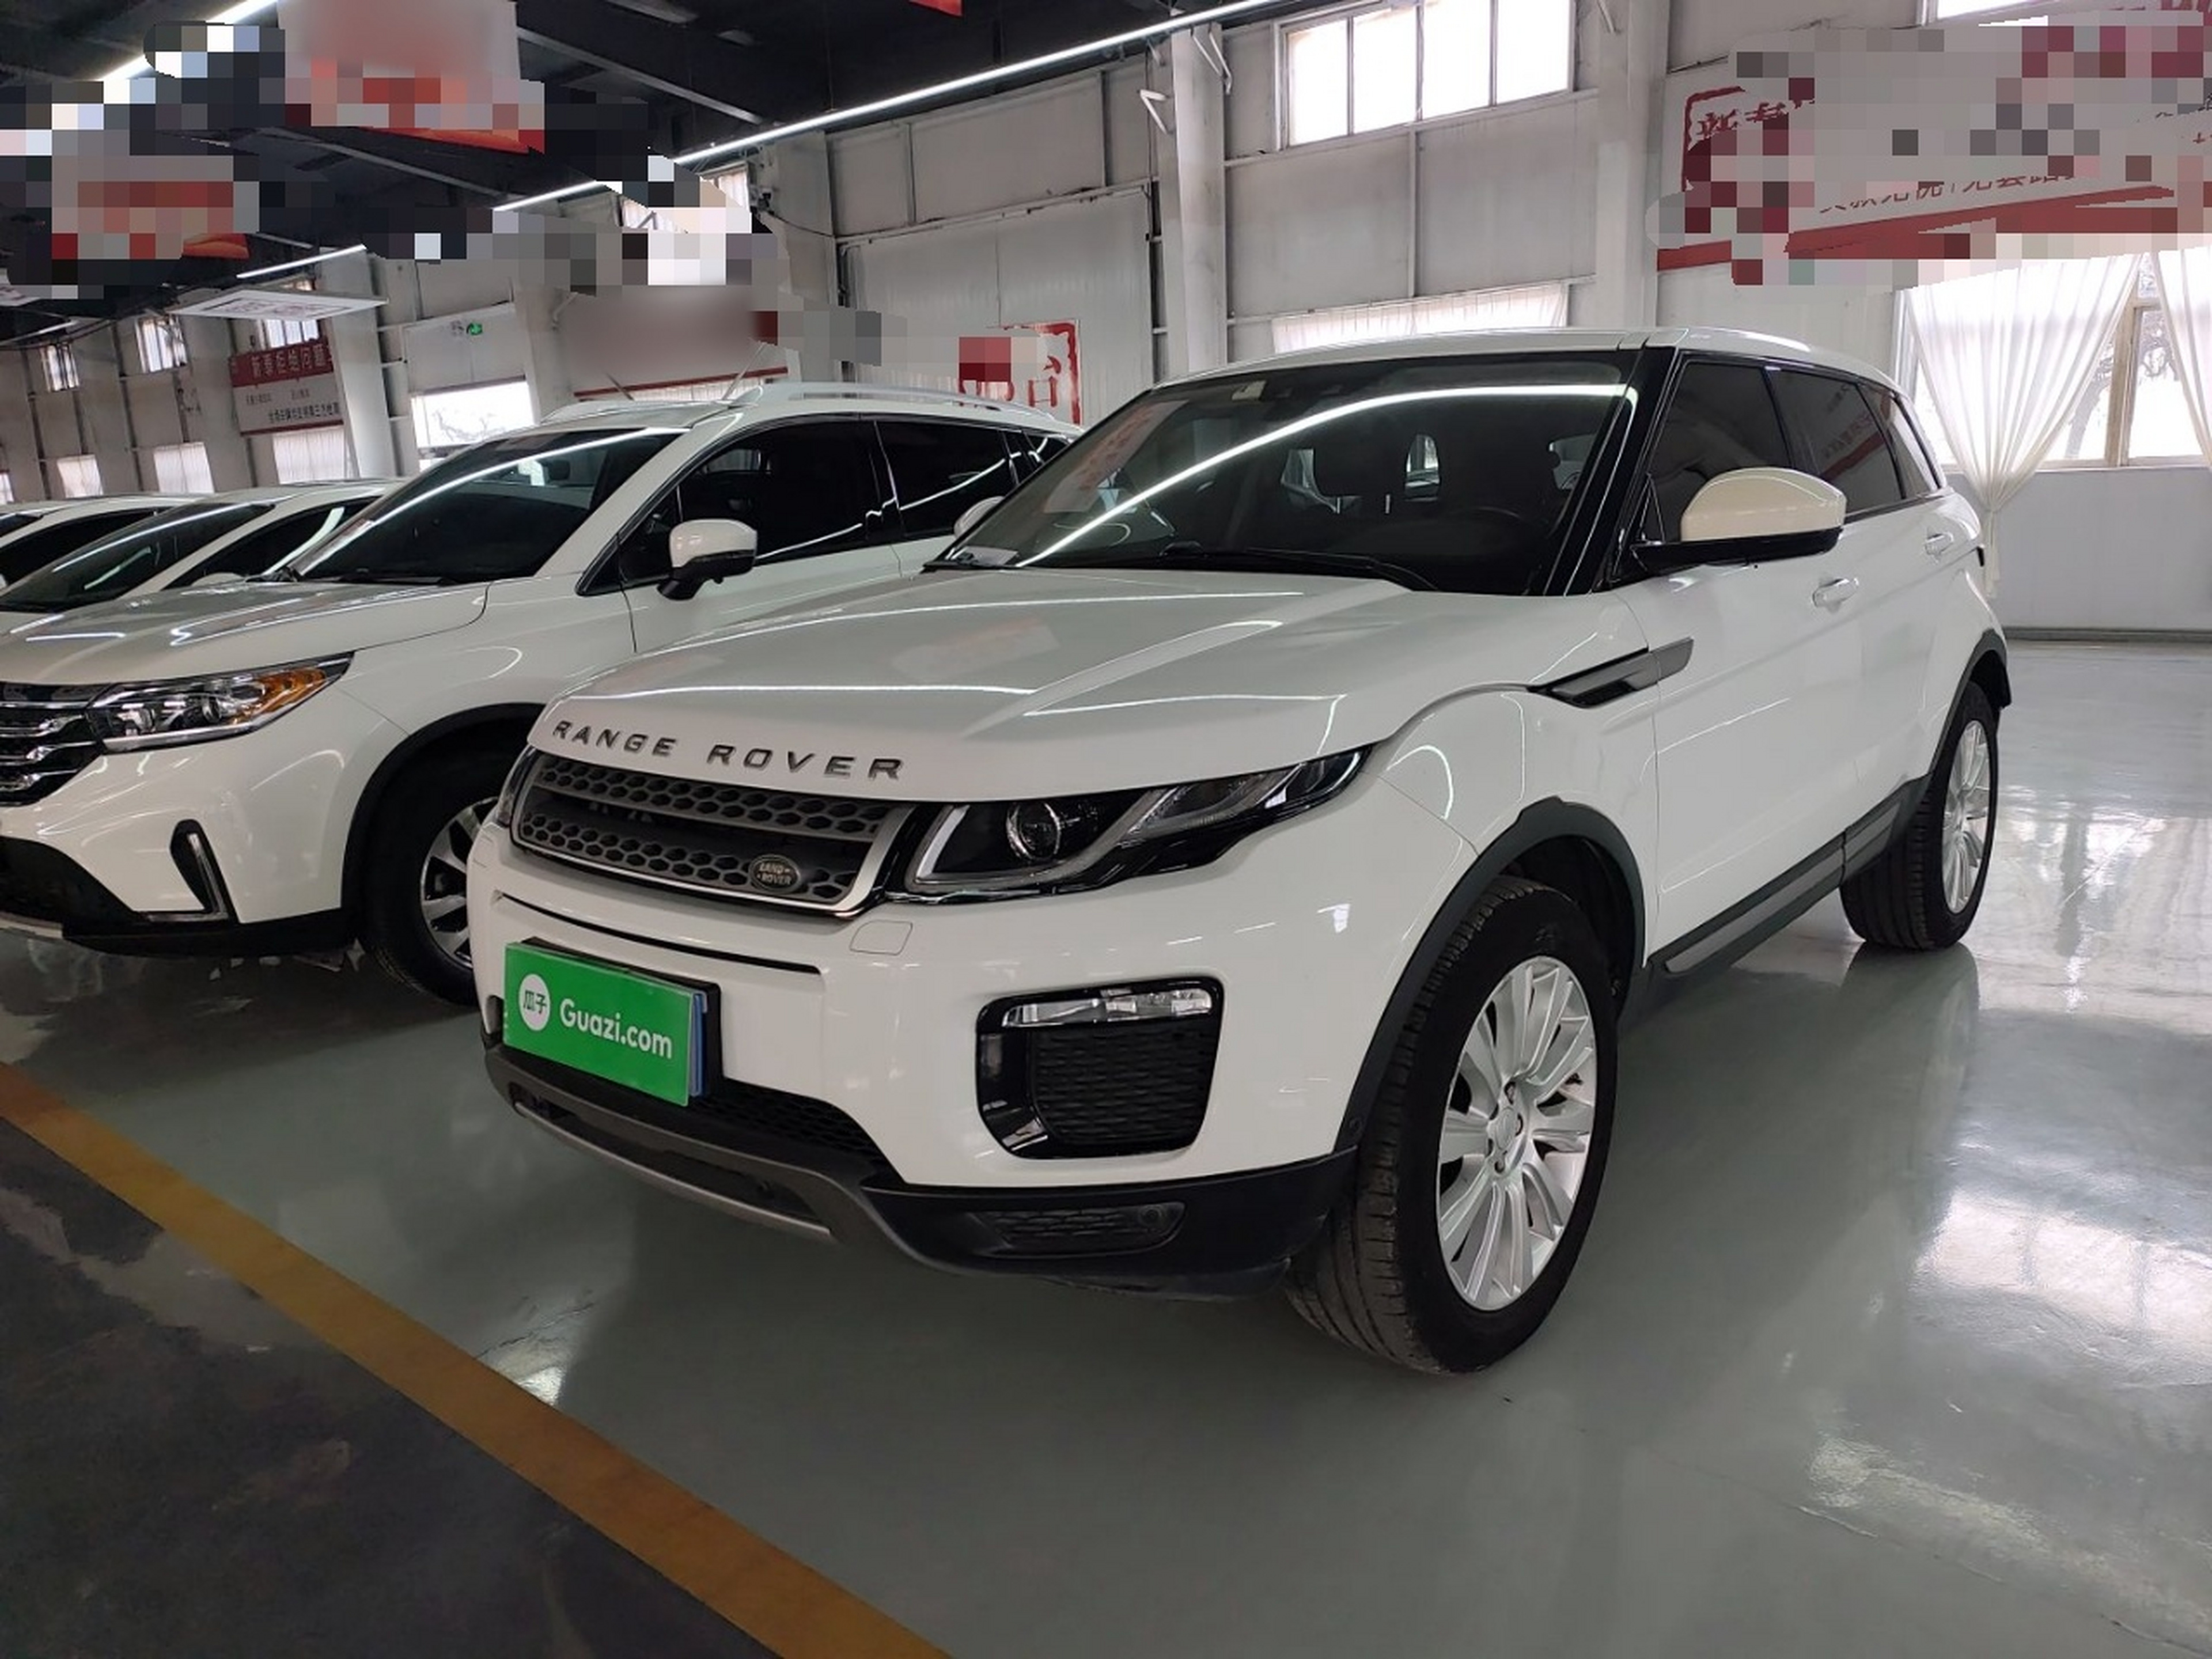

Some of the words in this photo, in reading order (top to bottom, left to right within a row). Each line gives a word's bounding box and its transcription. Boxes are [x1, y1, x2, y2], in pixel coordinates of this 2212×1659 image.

[552, 720, 677, 757] RANGE
[706, 745, 903, 780] ROVER
[522, 989, 547, 1014] 瓜子
[559, 998, 672, 1059] Guazi.com
